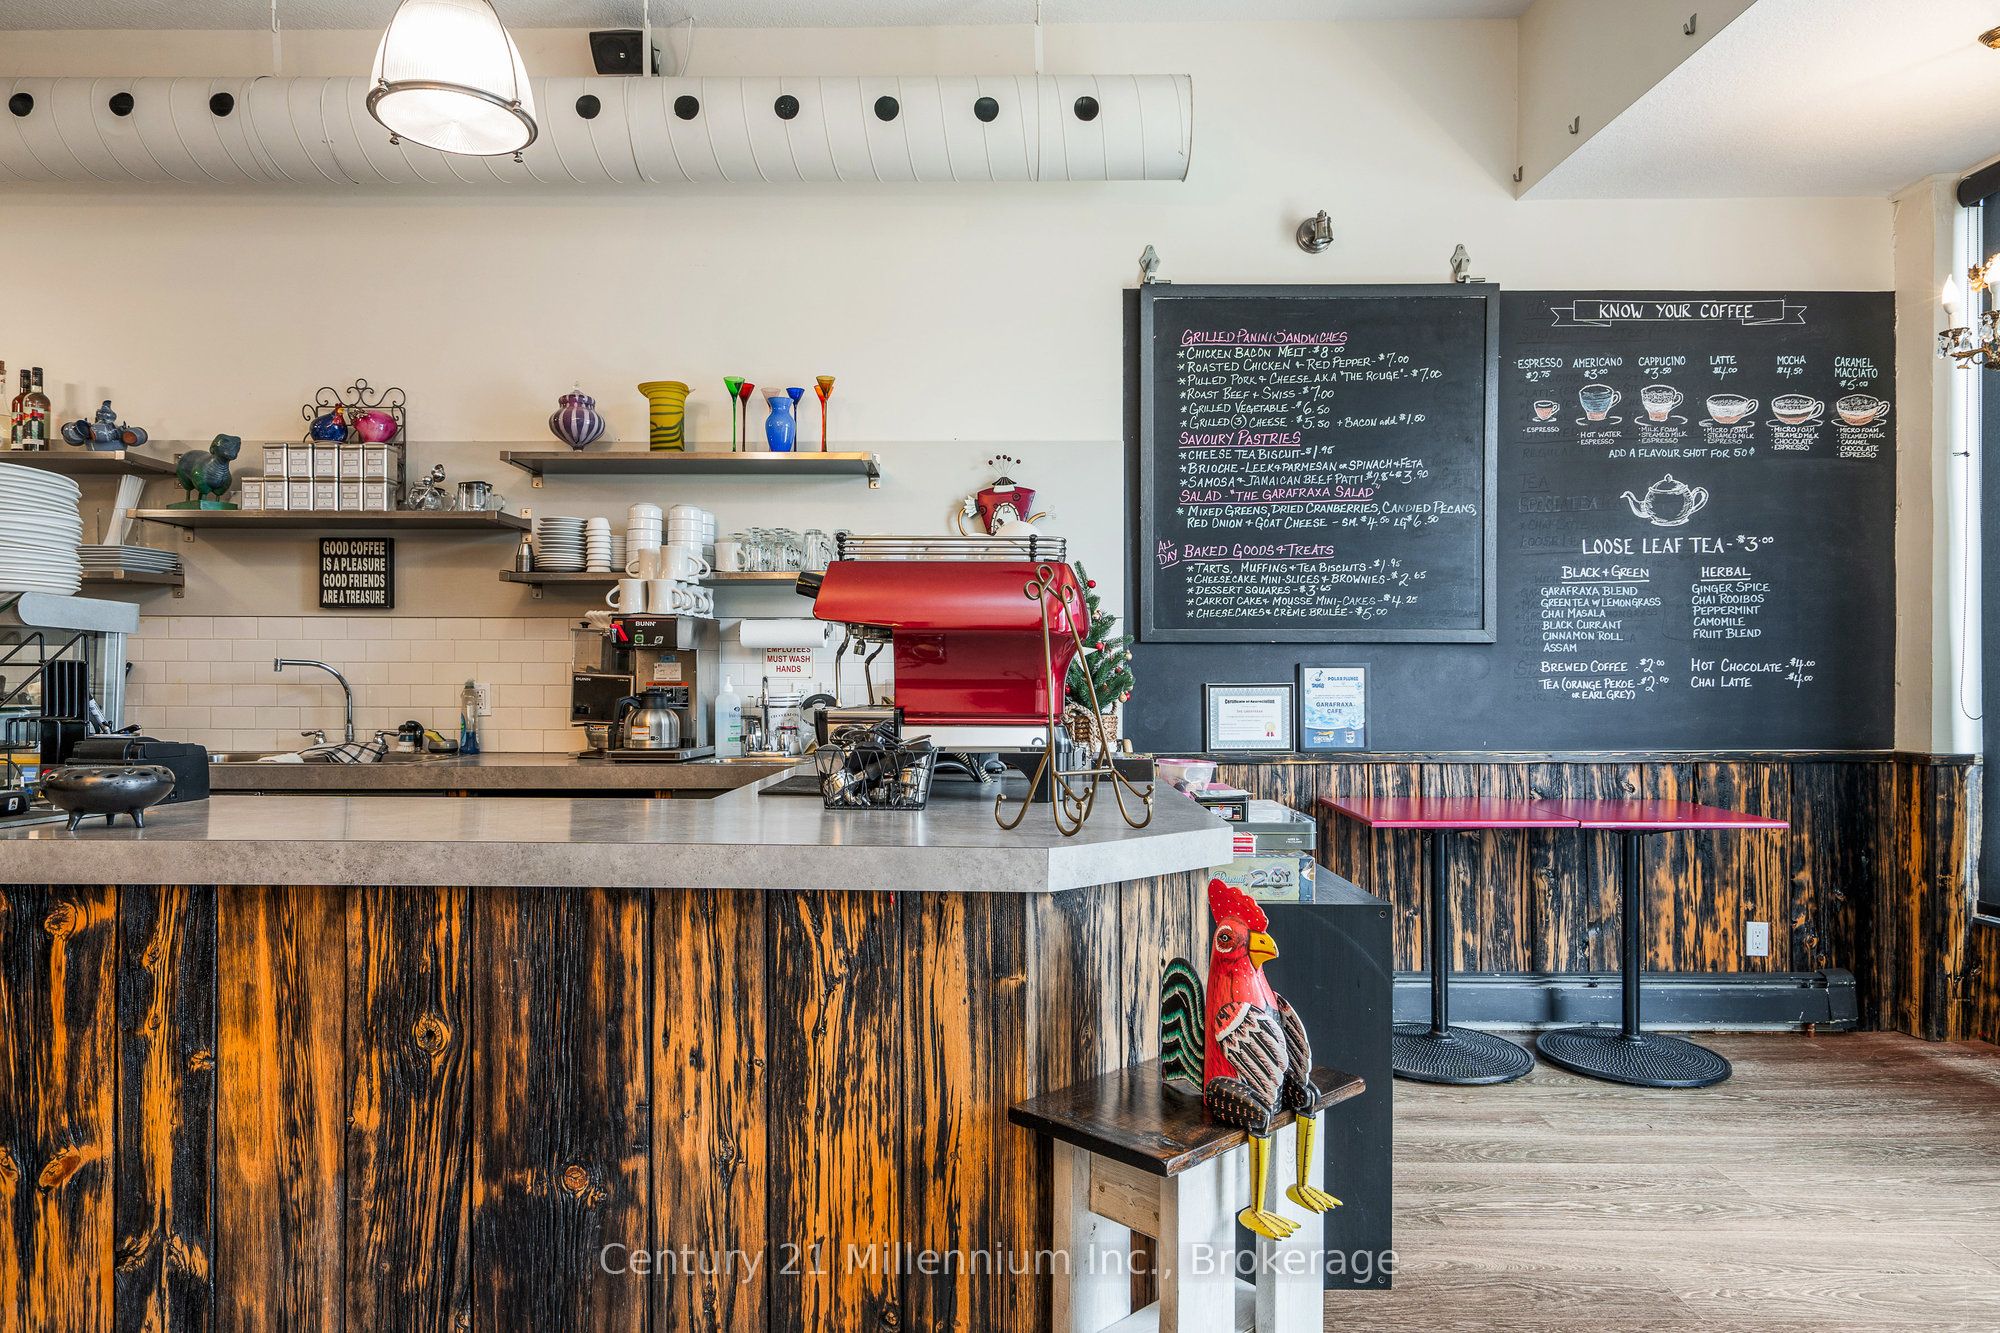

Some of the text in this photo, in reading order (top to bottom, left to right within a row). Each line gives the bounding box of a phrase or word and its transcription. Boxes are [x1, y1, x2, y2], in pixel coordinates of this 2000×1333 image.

[1599, 304, 1755, 319] KNOW YOUR COFFEE
[1182, 329, 1348, 344] GRILLED PANINI SANDWICHES
[1187, 347, 1231, 359] CHICKEN
[1234, 347, 1271, 358] BACON
[1278, 346, 1307, 357] MELT
[1187, 352, 1409, 372] ROASTED CHICKEN RED $7.00
[1518, 358, 1563, 369] ESPRESSO
[1572, 358, 1623, 367] AMERICANO
[1638, 356, 1686, 366] CAPPUCINO
[1710, 356, 1737, 365] LATTE
[1777, 355, 1806, 365] MOCHA
[1835, 357, 1874, 367] CARAMEL
[1188, 367, 1442, 386] PULLED PORK CHEESE $7.00
[1835, 368, 1878, 378] MACCIATO
[1187, 385, 1334, 401] ROAST BEEF SWISS $7.00
[1189, 401, 1288, 415] GRILLED VEGETABLE
[1190, 416, 1377, 429] GRILLED CHEESE BACON
[1179, 430, 1301, 445] SAVOURY PASTRIES
[1188, 449, 1301, 460] CHEESE TEA BISCUIT
[1609, 449, 1730, 458] ADD A FLAVOUR SHOT FOR
[1188, 457, 1424, 474] BRIOCHE PARMESAN SPINACH FETA
[1187, 473, 1363, 488] SAMOSA JAMAICAN BEEF PATTI
[1179, 487, 1330, 502] SALAD GARAFRAXA
[1188, 501, 1477, 517] MIXED GREENS, DRIED CRANBERRIES, CANDIED PECANS,
[1187, 516, 1327, 530] RED ONION GOAT CHEESE
[323, 541, 385, 555] GOOD COFFEE
[1158, 540, 1175, 554] ALL
[1183, 543, 1335, 558] BAKED GOODS TREATS
[1582, 538, 1634, 555] LOOSE
[1643, 538, 1684, 554] LEAF
[1688, 537, 1724, 553] TEA
[1156, 549, 1178, 565] DAY
[323, 557, 385, 571] IS A PLEASURE
[1194, 562, 1367, 574] TARTS, MUFFINS TEA BISCUITS
[1561, 565, 1649, 579] BLACK GREEN
[1701, 567, 1751, 577] HERBAL
[323, 574, 385, 587] GOOD FRIENDS
[1193, 574, 1386, 584] CHEESECAKE MINI-SLICES BROWNIES
[1195, 585, 1291, 595] DESSERT SQUARES
[1541, 586, 1638, 598] GARAFRAXA BLEND
[1692, 582, 1770, 595] GINGER SPICE
[323, 590, 385, 603] ARE A TREASURE
[1195, 596, 1376, 606] CARROT CAKE MOUSSE MINI-CAKES
[1692, 594, 1764, 604] CHAI ROOIBOS
[1541, 598, 1661, 609] GREEN TEA LEMONGRASS
[1196, 605, 1348, 618] CHEESECAKES CRÈME BRULÉE
[1542, 609, 1606, 618] CHAI MASALA
[1693, 606, 1761, 616] PEPPERMINT
[1542, 620, 1622, 630] BLACK CURRANT
[1694, 617, 1745, 626] CAMOMILE
[1543, 631, 1623, 641] CINNAMON ROLL
[1693, 629, 1761, 638] FRUIT BLEND
[1543, 644, 1577, 652] ASSAM
[1540, 660, 1628, 672] BREWED COFFEE
[1691, 658, 1782, 672] HOT CHOCOLATE
[1539, 677, 1635, 691] TEA (ORANGE PEKOE
[1691, 676, 1752, 688] CHAI LATTE
[1582, 690, 1635, 700] EARL GREY)
